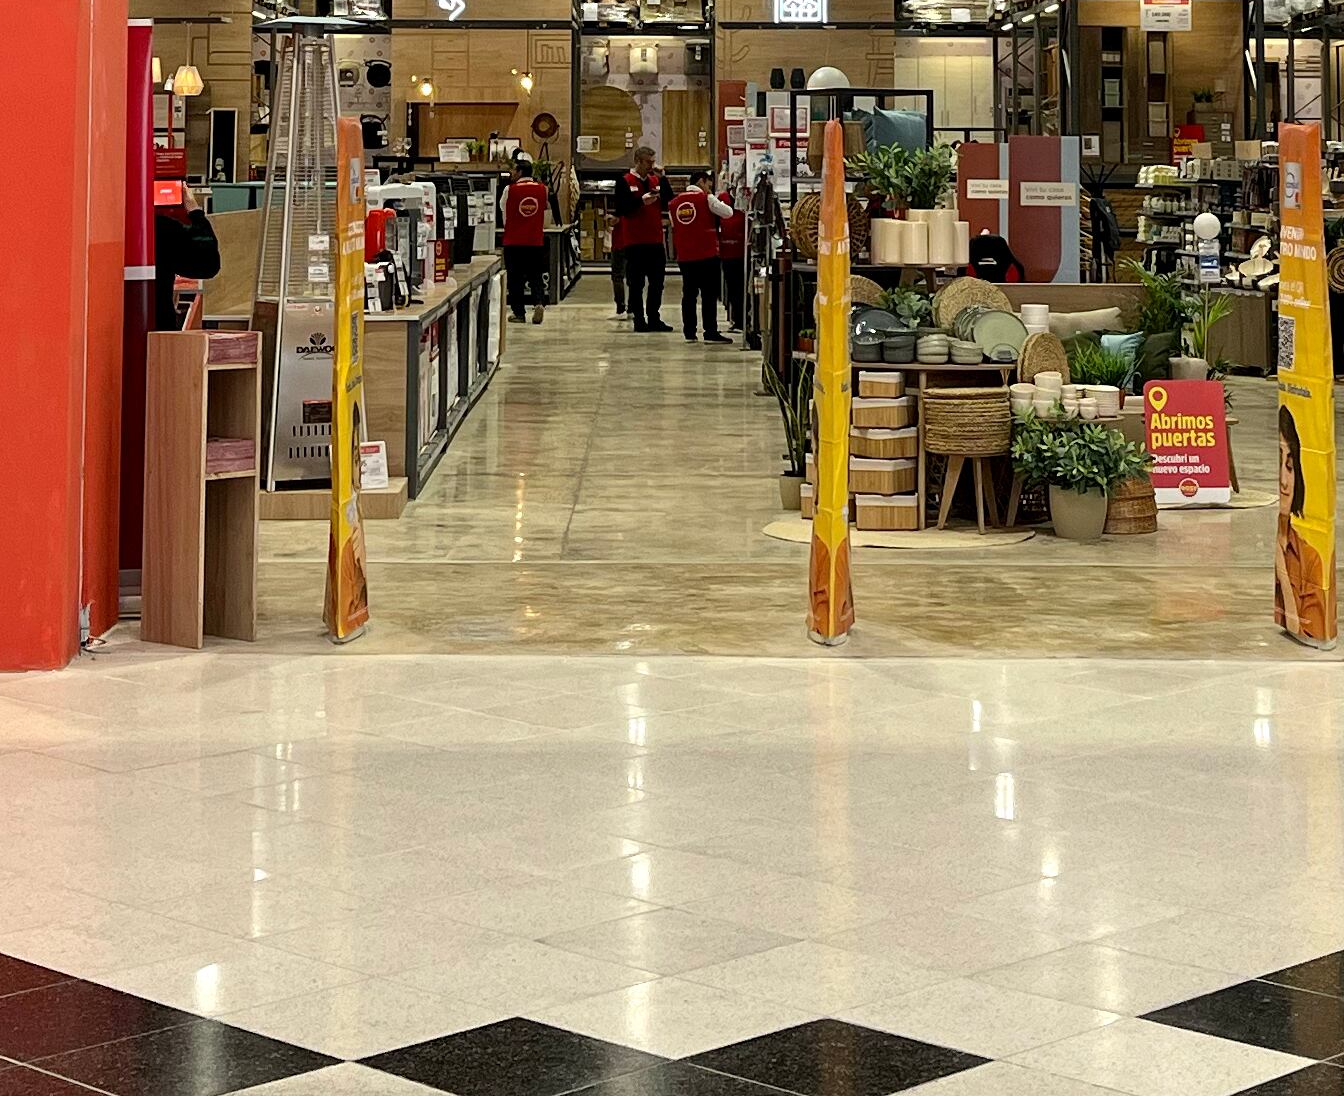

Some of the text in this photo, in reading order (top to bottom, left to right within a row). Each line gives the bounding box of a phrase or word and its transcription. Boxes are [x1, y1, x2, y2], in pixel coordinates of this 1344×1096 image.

[1151, 413, 1214, 430] Abrimos
[1152, 430, 1216, 450] puertas
[1179, 464, 1211, 475] espacio
